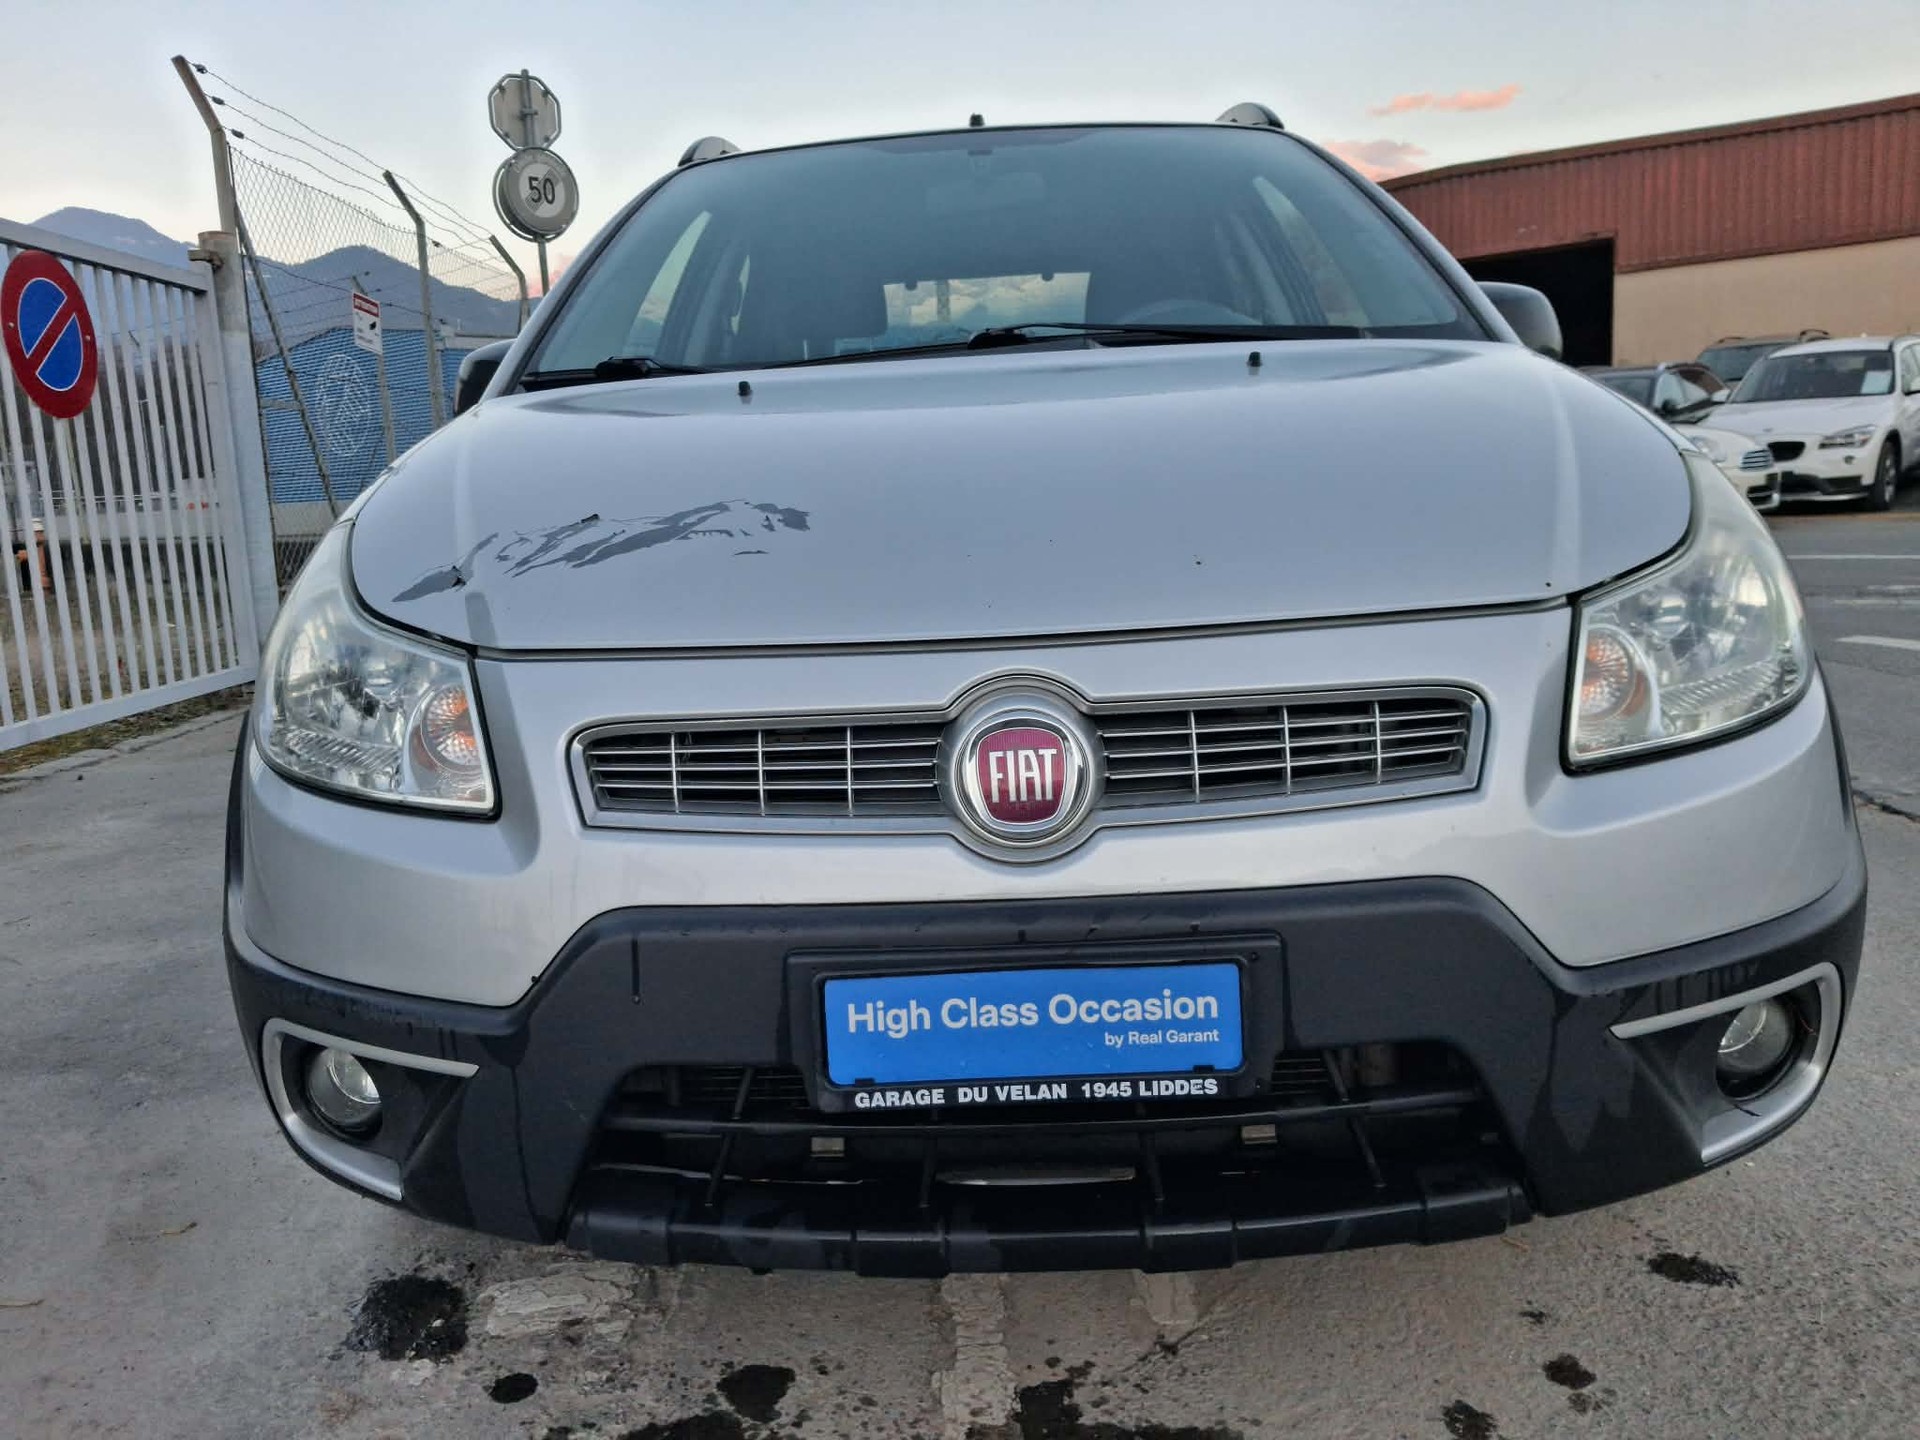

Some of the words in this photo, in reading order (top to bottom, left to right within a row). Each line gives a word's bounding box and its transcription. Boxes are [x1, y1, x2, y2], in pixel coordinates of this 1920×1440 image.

[529, 176, 556, 204] 50
[989, 749, 1058, 803] FIAT
[847, 998, 931, 1038] High
[941, 996, 1039, 1029] Class
[1048, 988, 1219, 1025] Occasion
[1104, 1031, 1124, 1048] by
[1128, 1029, 1162, 1044] Real
[1165, 1028, 1220, 1044] Garant
[854, 1086, 946, 1109] GARAGE
[957, 1085, 989, 1104] DU
[994, 1082, 1068, 1102] VELAN
[1081, 1080, 1132, 1099] 1945
[1138, 1078, 1219, 1097] LIDDES
